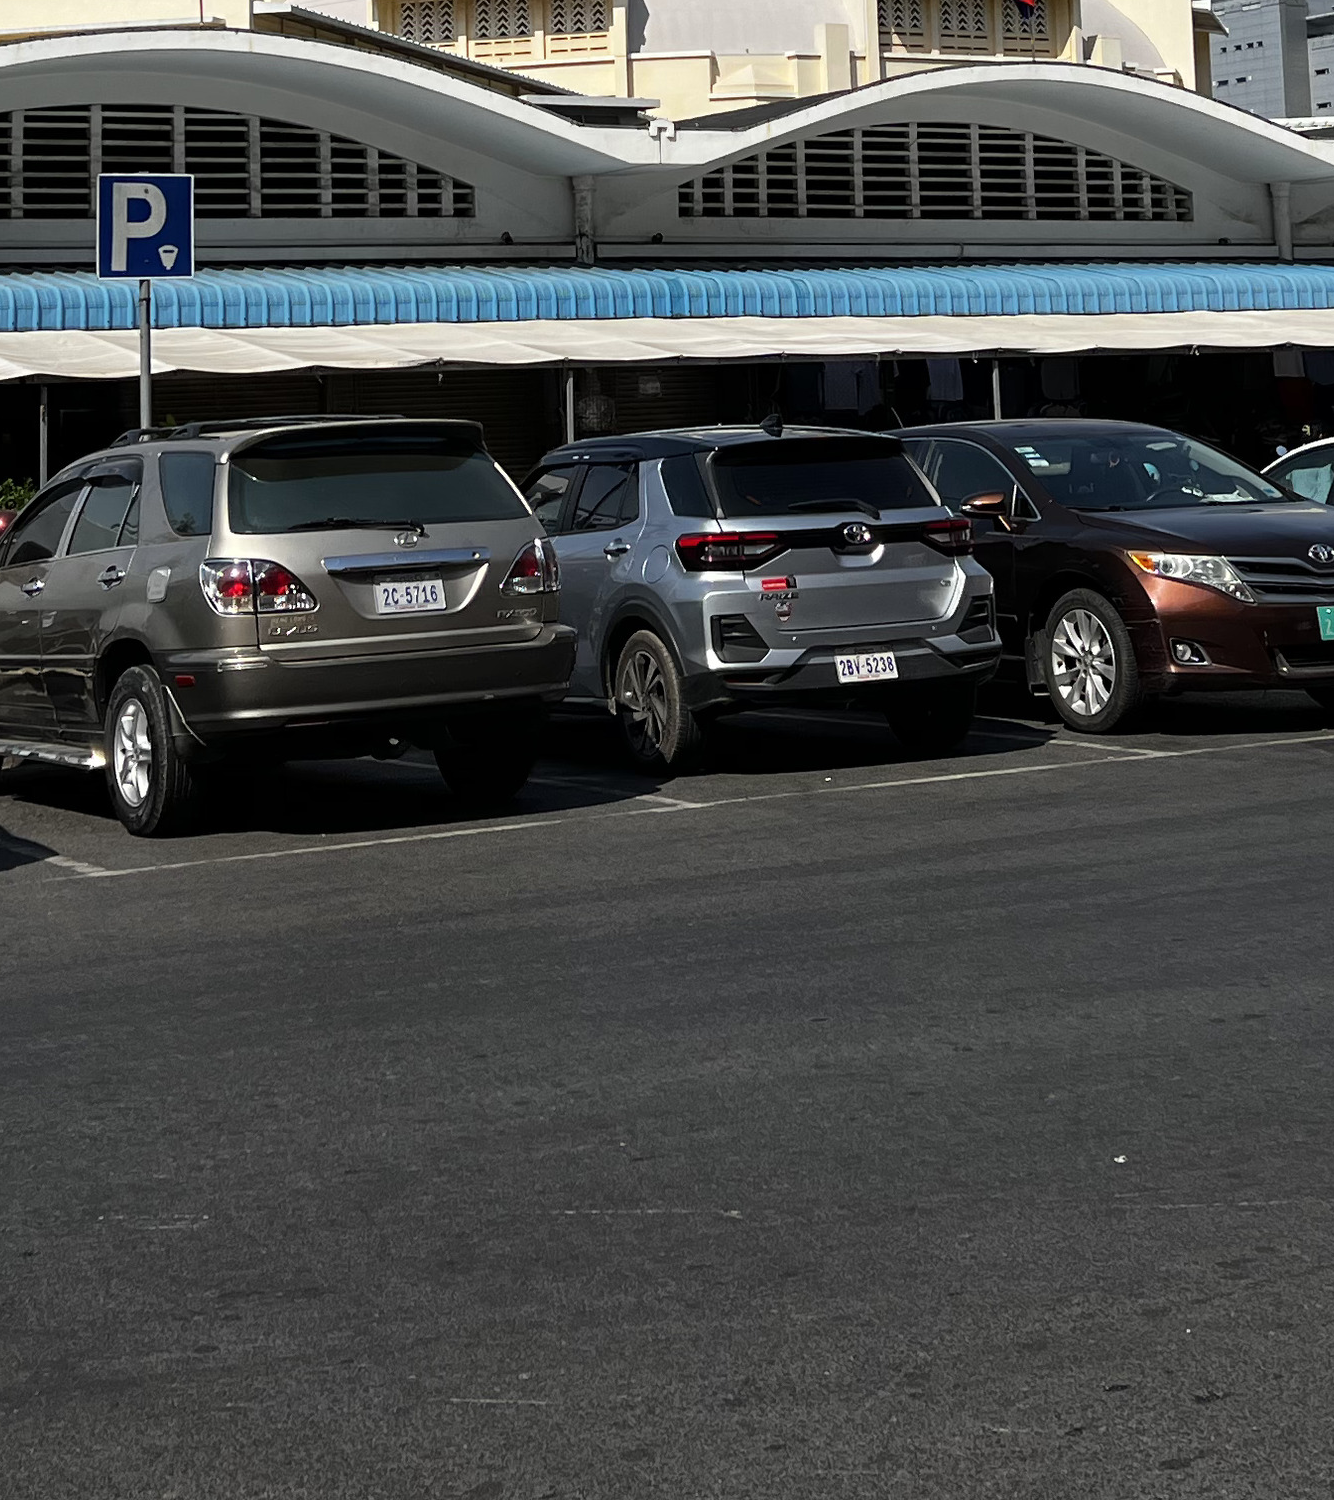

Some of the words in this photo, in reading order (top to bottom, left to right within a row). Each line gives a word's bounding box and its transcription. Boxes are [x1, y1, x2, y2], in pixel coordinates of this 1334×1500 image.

[111, 182, 167, 271] P
[382, 584, 438, 606] 2C-5716
[839, 656, 894, 677] 2BV-5238
